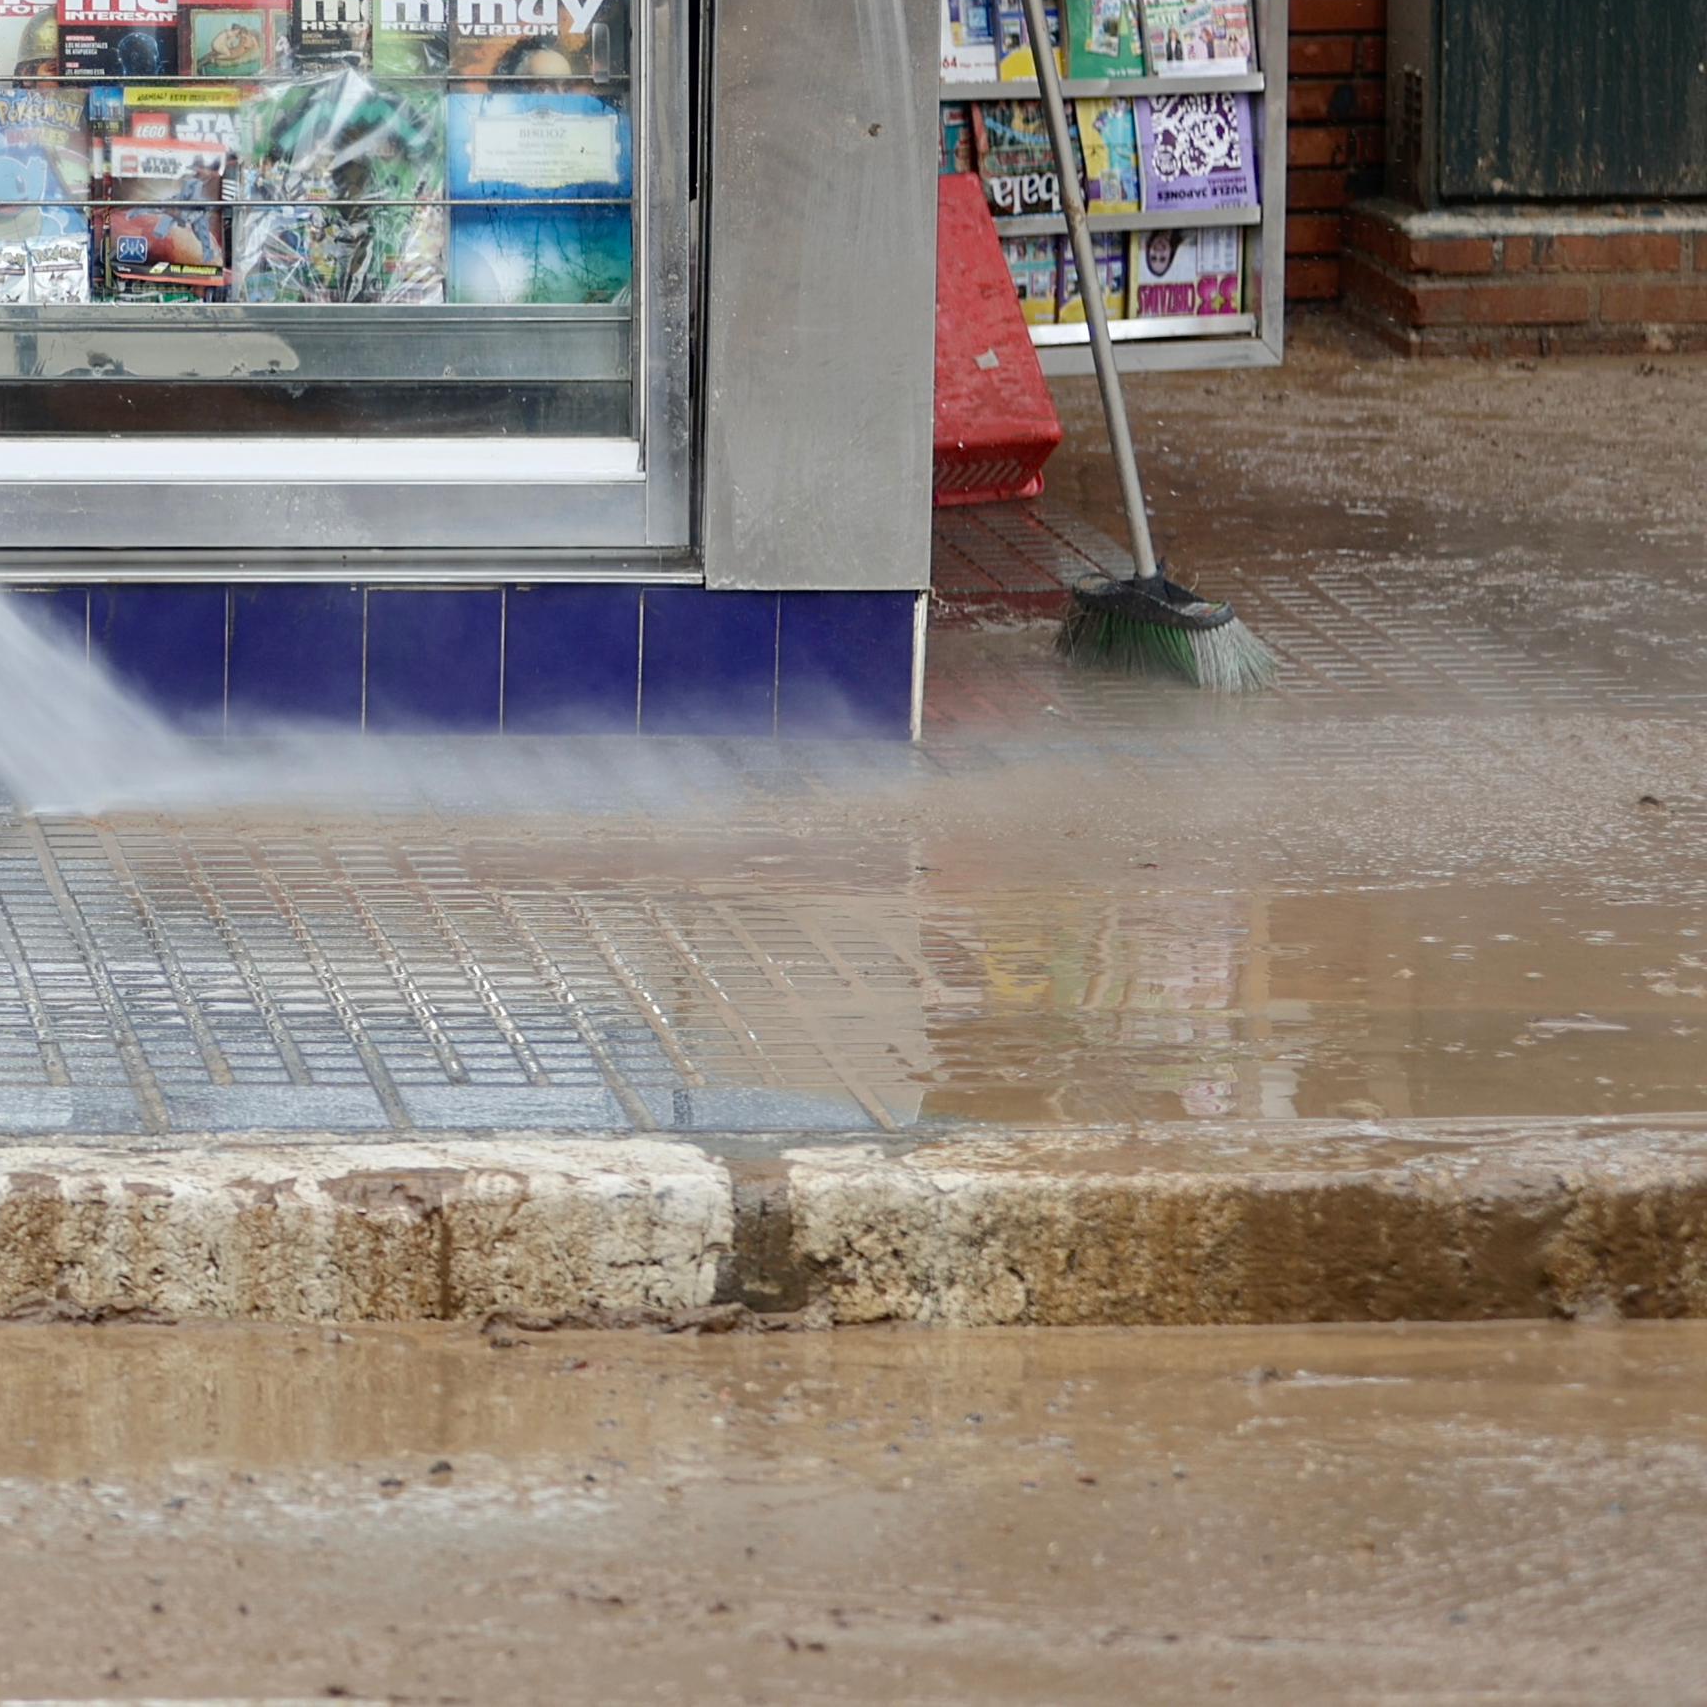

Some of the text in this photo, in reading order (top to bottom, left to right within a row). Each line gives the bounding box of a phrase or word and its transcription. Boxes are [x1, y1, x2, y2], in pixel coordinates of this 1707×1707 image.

[457, 24, 559, 36] VERBUM
[136, 125, 167, 137] LEGO
[1196, 274, 1239, 315] 33
